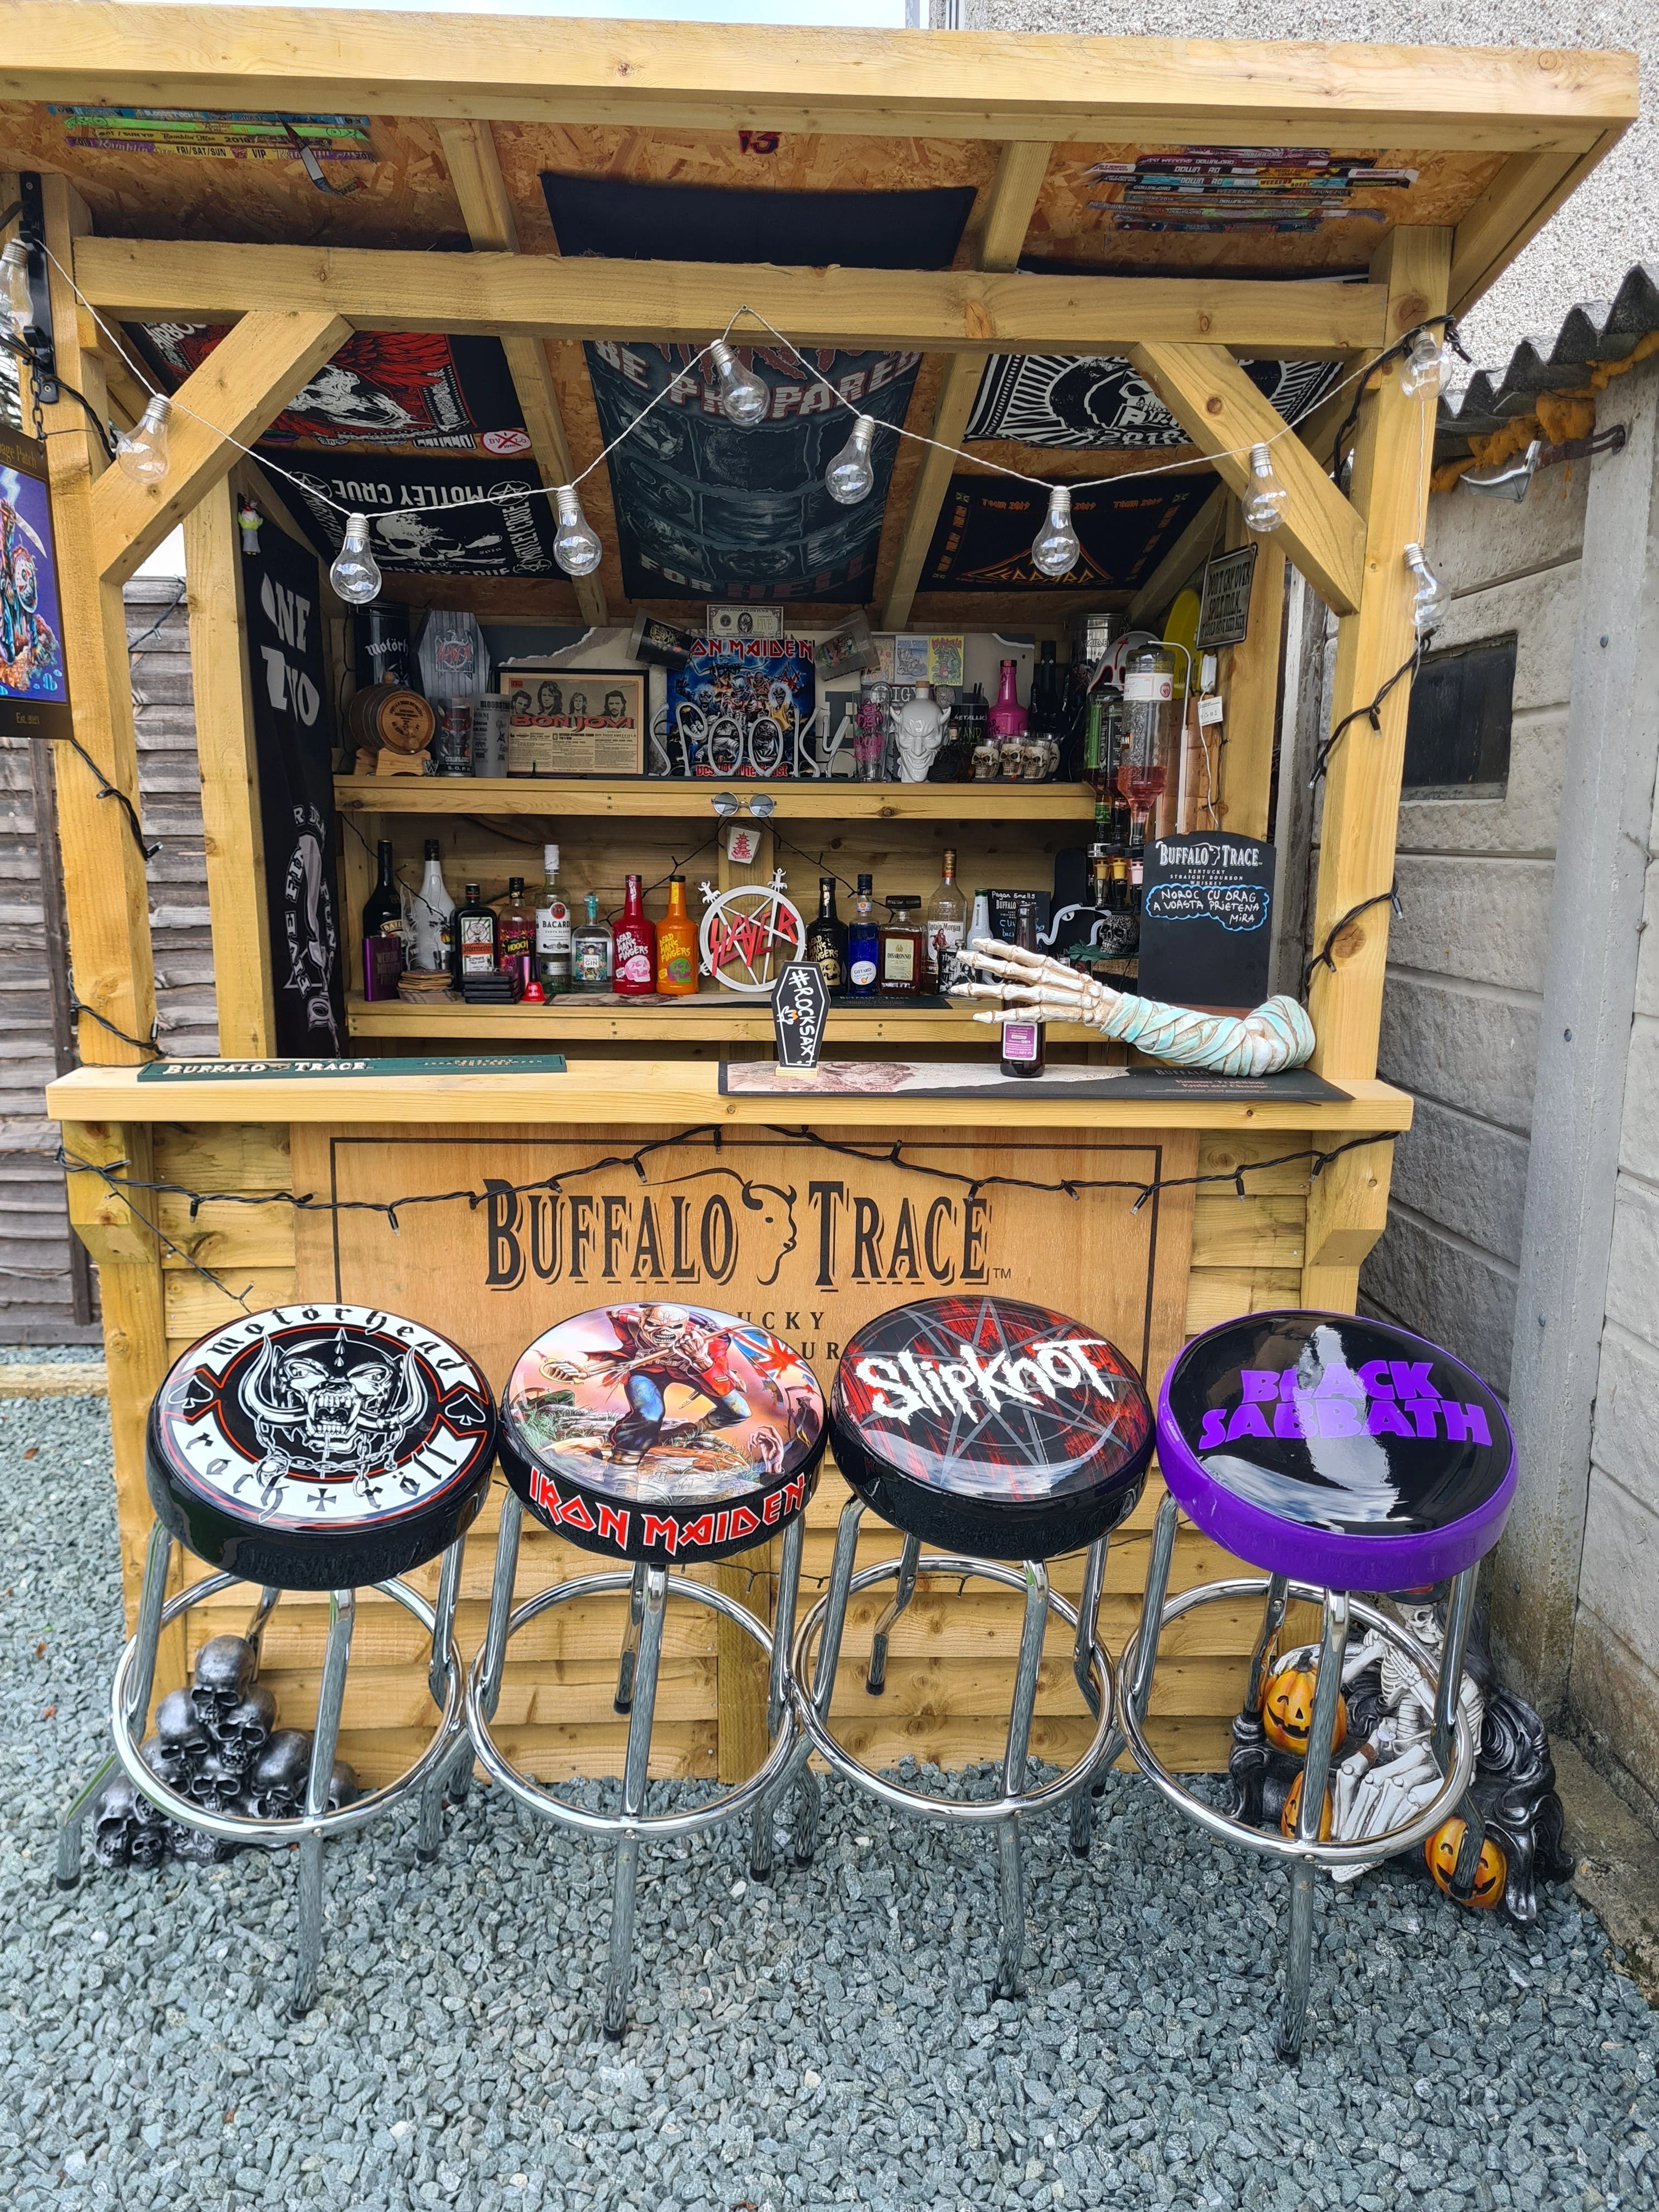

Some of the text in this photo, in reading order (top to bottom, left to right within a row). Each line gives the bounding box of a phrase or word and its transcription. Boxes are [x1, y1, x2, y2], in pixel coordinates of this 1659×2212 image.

[176, 145, 227, 157] FRI/SAT/SUN
[252, 149, 267, 159] VIP
[668, 351, 922, 419] PRPARED
[16, 444, 37, 469] Patch
[1234, 561, 1251, 589] OVER
[757, 618, 772, 630] FIVE
[728, 639, 815, 664] MAIDEN
[511, 714, 636, 733] BON JOVI
[1156, 842, 1260, 867] BUFFALO TRACE
[991, 890, 1011, 900] Pagan
[1161, 888, 1257, 903] NOROC CU DRAG
[996, 900, 1017, 910] BUFFALO
[1153, 901, 1161, 912] A
[1163, 899, 1204, 911] VOASTA
[928, 922, 961, 933] Captain Morgan
[507, 939, 528, 952] HOOCH
[616, 932, 632, 946] DEAD
[617, 938, 636, 953] MAN'S
[659, 933, 674, 947] DEAD
[660, 940, 679, 954] MAN'S
[709, 903, 799, 977] SLAYER
[618, 945, 648, 962] FINGERS
[661, 947, 691, 963] FINGERS
[788, 969, 817, 1057] #ROCKSAX
[162, 1061, 366, 1075] BUFFALO TRACE
[483, 1178, 740, 1292] BUFFALO
[808, 1181, 992, 1293] TRACE
[737, 1312, 825, 1330] UCKY
[1240, 1360, 1444, 1404] BLACK
[1199, 1399, 1493, 1450] SABBATH
[528, 1466, 806, 1557] IRON MAIDEN
